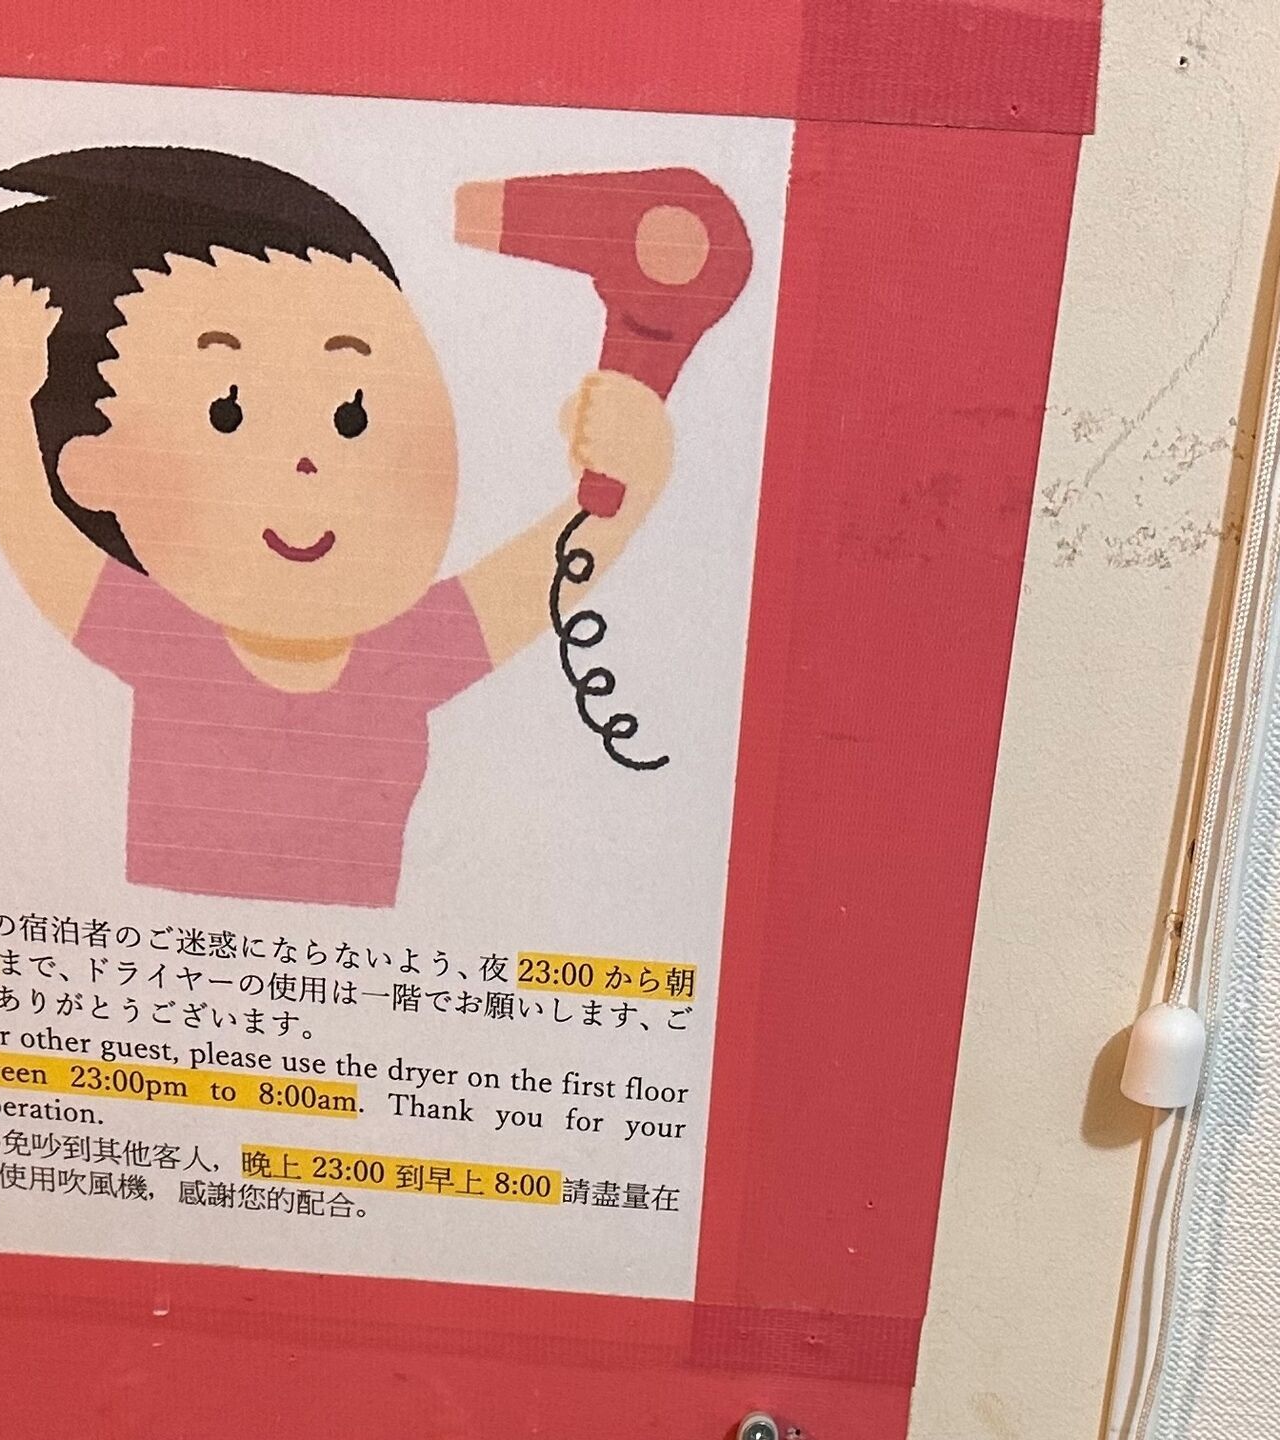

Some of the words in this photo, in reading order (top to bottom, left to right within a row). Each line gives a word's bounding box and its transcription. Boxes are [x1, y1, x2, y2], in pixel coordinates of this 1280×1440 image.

[0, 948, 694, 1033] まで、ドライヤーの使用は一階でお願いします、ご
[519, 957, 594, 988] 23:00
[605, 964, 696, 999] から朝
[20, 1027, 91, 1054] other
[100, 1037, 180, 1066] guest,
[189, 1041, 272, 1072] please
[282, 1053, 326, 1075] use
[336, 1053, 378, 1080] the
[388, 1057, 459, 1090] dryer
[468, 1071, 500, 1091] on
[510, 1067, 553, 1095] the
[562, 1071, 616, 1099] first
[625, 1077, 690, 1104] floor
[70, 1065, 189, 1101] 23:00pm
[211, 1081, 237, 1102] to
[259, 1082, 365, 1113] 8:00am.
[388, 1092, 474, 1123] Thank
[495, 1108, 543, 1131] you
[565, 1107, 603, 1133] for
[624, 1117, 687, 1142] your
[312, 1155, 386, 1184] 23:00
[395, 1163, 485, 1197] 到早上
[494, 1172, 552, 1198] 8:00
[562, 1177, 681, 1213] 請盡量在
